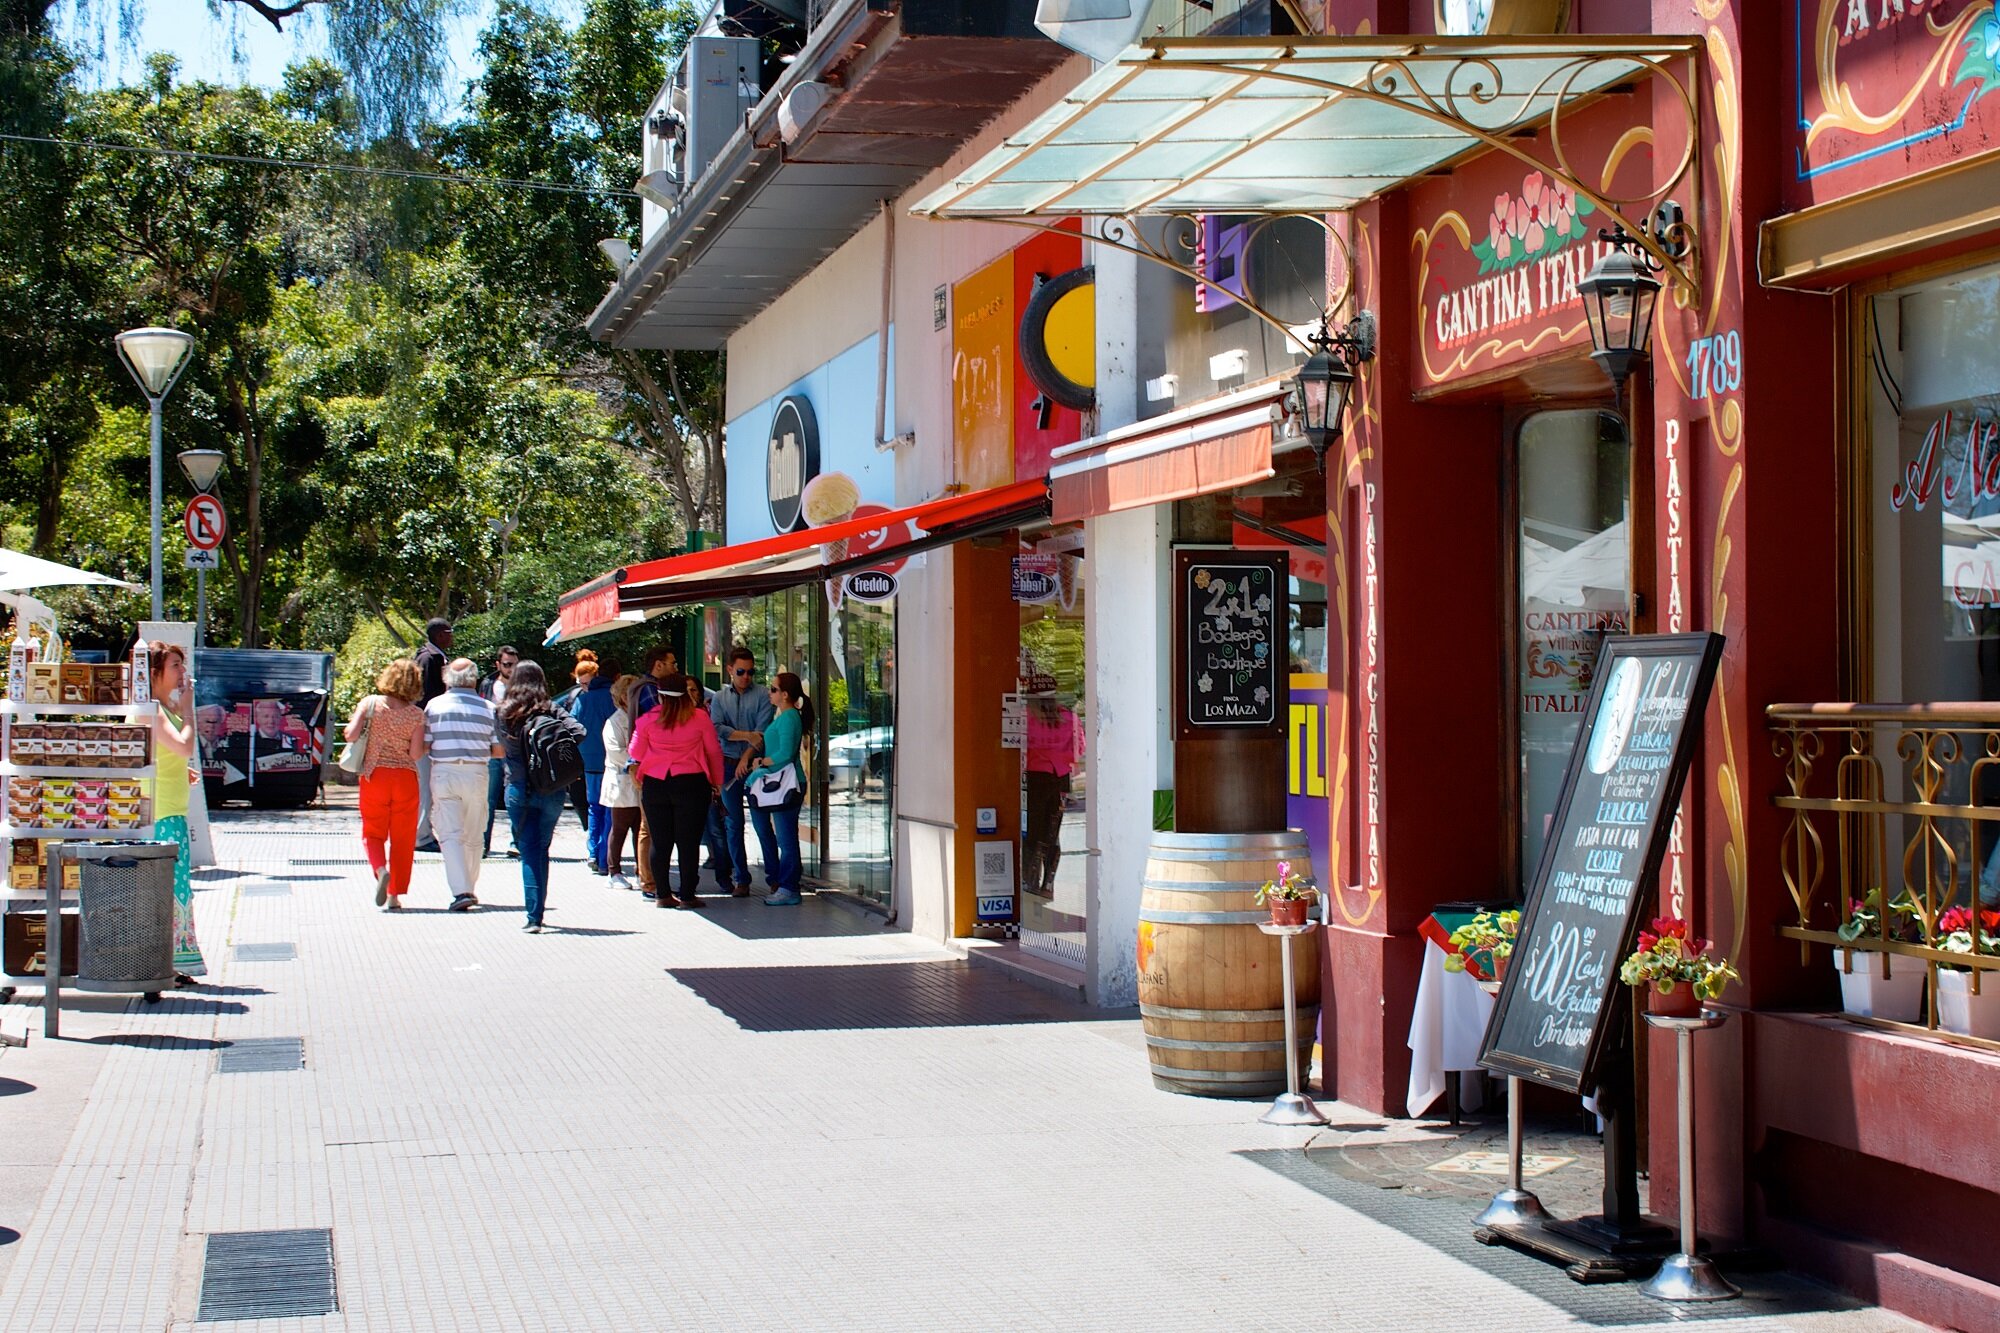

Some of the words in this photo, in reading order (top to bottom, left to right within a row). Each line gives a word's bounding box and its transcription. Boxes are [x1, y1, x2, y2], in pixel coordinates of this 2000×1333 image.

[1436, 265, 1532, 343] CANTINA
[1686, 330, 1742, 400] 1789
[854, 577, 889, 592] freddo
[1364, 482, 1379, 667] PASTAS
[1204, 576, 1259, 619] 2x1
[1198, 620, 1266, 650] Bodegas
[1252, 615, 1269, 627] en
[1525, 612, 1628, 631] CANTINA
[1207, 648, 1267, 678] Boutique
[1205, 703, 1224, 717] LOS
[1225, 703, 1258, 716] MAZA
[1365, 671, 1380, 890] CASERAS
[982, 900, 1011, 912] VISA
[1575, 950, 1605, 989] Cash
